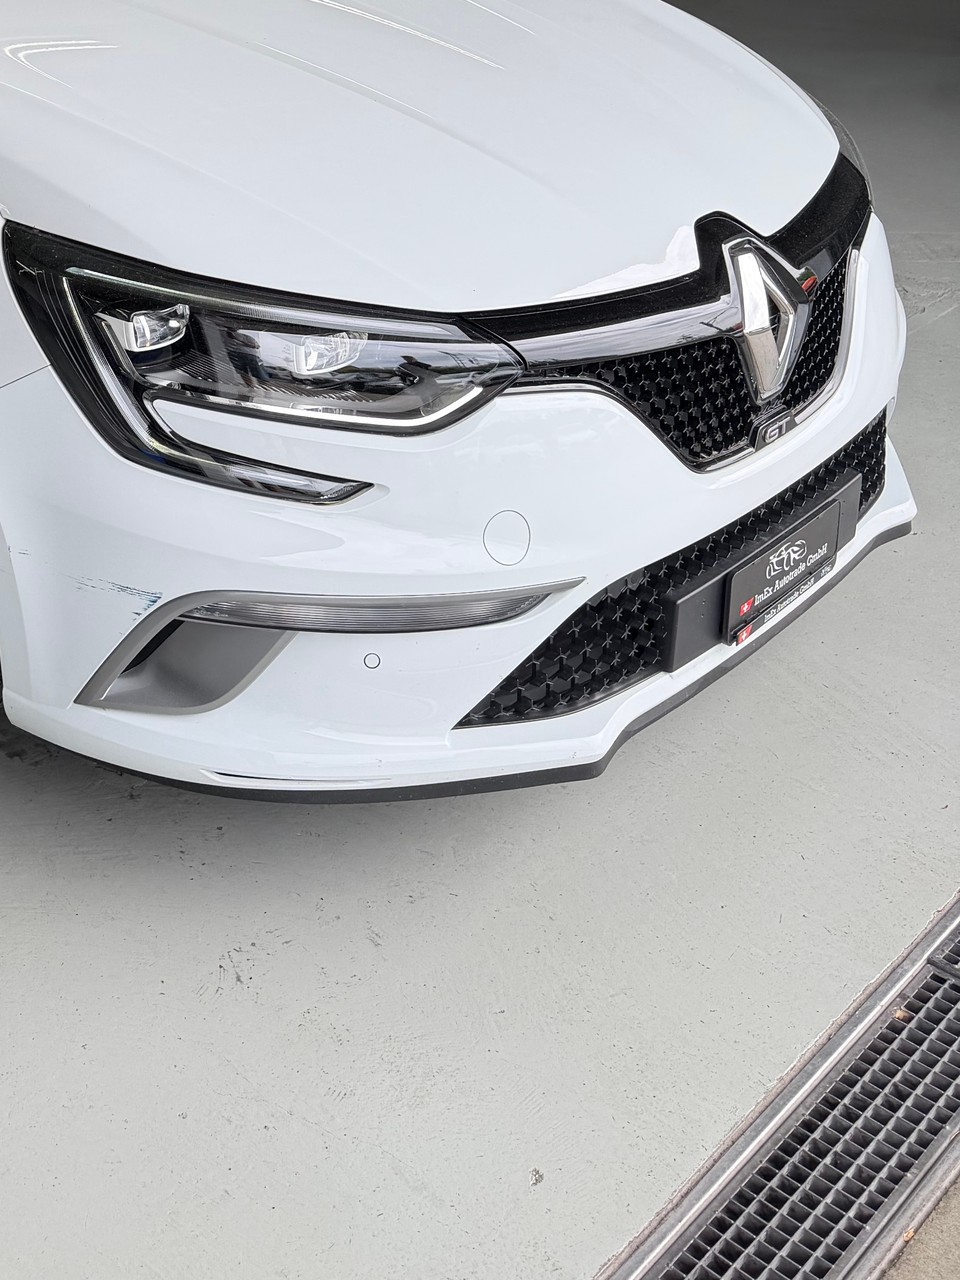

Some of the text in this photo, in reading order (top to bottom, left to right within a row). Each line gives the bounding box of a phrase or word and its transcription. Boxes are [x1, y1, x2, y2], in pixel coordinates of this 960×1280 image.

[765, 416, 791, 443] GT
[754, 586, 774, 606] ImEx
[773, 561, 806, 593] Autotrade
[806, 542, 828, 567] GmbH
